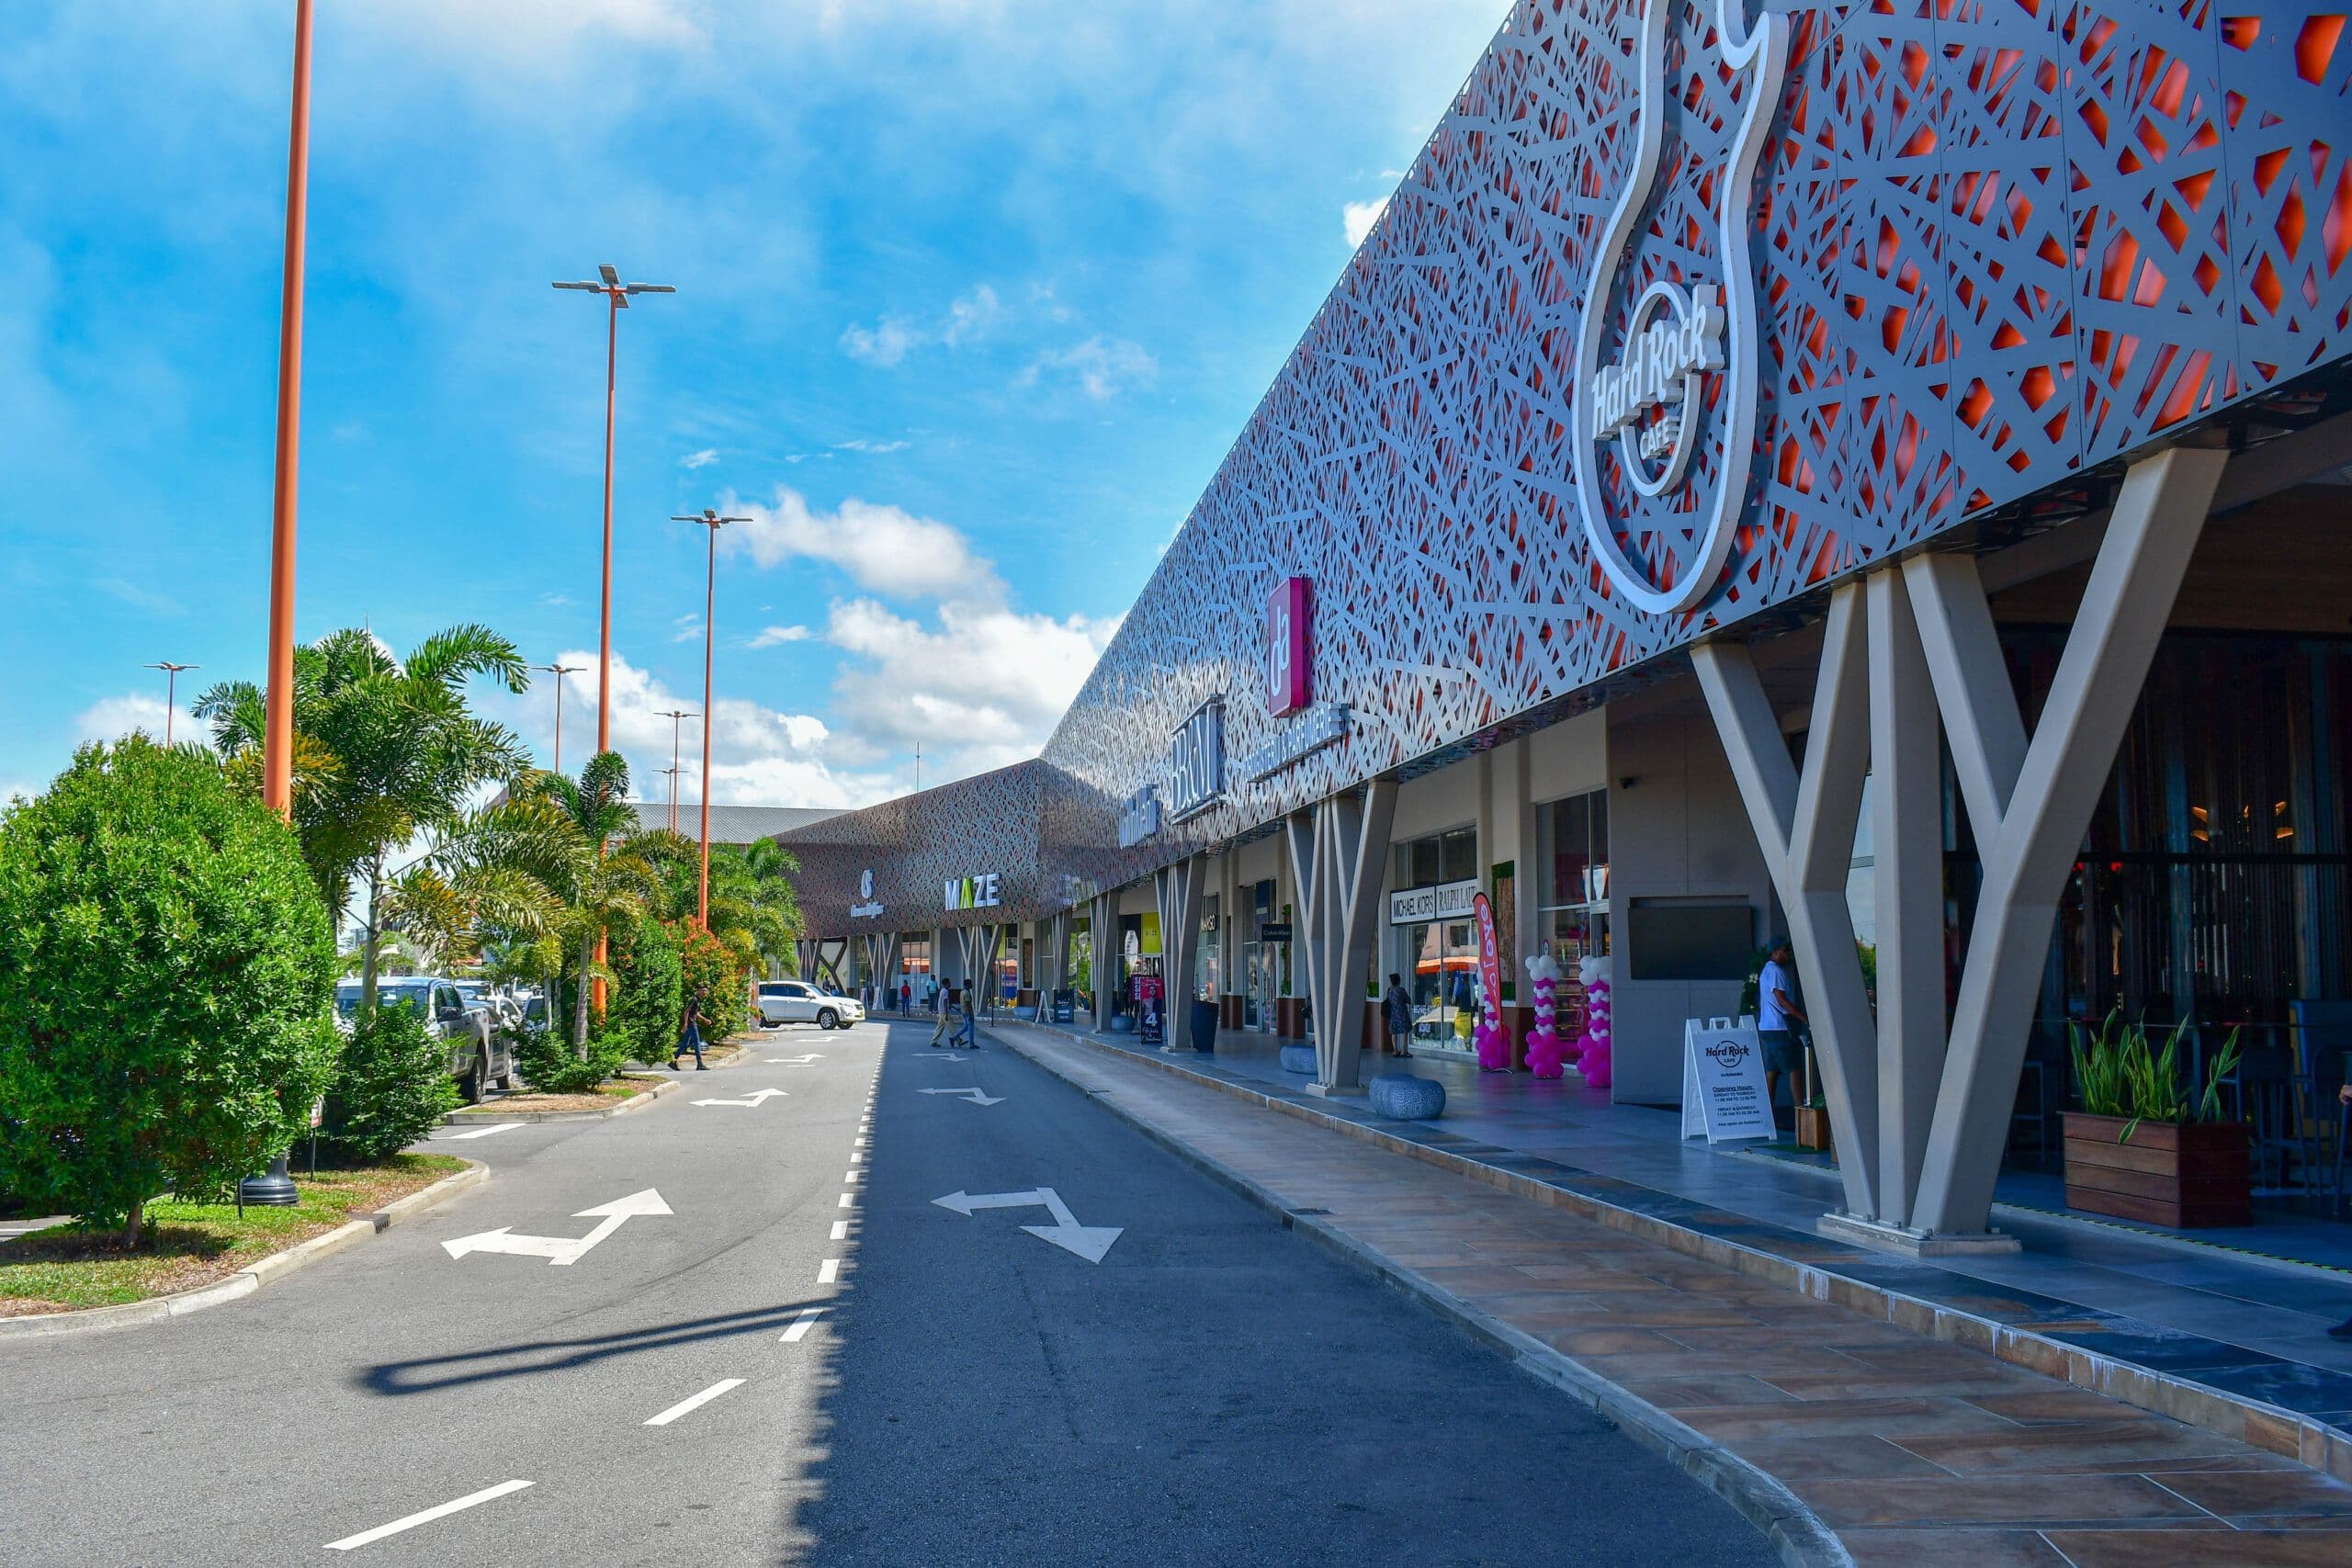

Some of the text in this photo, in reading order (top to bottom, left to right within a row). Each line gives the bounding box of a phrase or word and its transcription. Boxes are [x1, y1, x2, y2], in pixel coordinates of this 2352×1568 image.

[1592, 284, 1714, 440] Hard Rock
[1640, 416, 1676, 459] CAFE
[944, 873, 1000, 911] MAZE
[1393, 895, 1434, 918] MICHAEL KORS
[1439, 886, 1477, 911] RALPH LAU
[1705, 1045, 1749, 1056] Hard Rock
